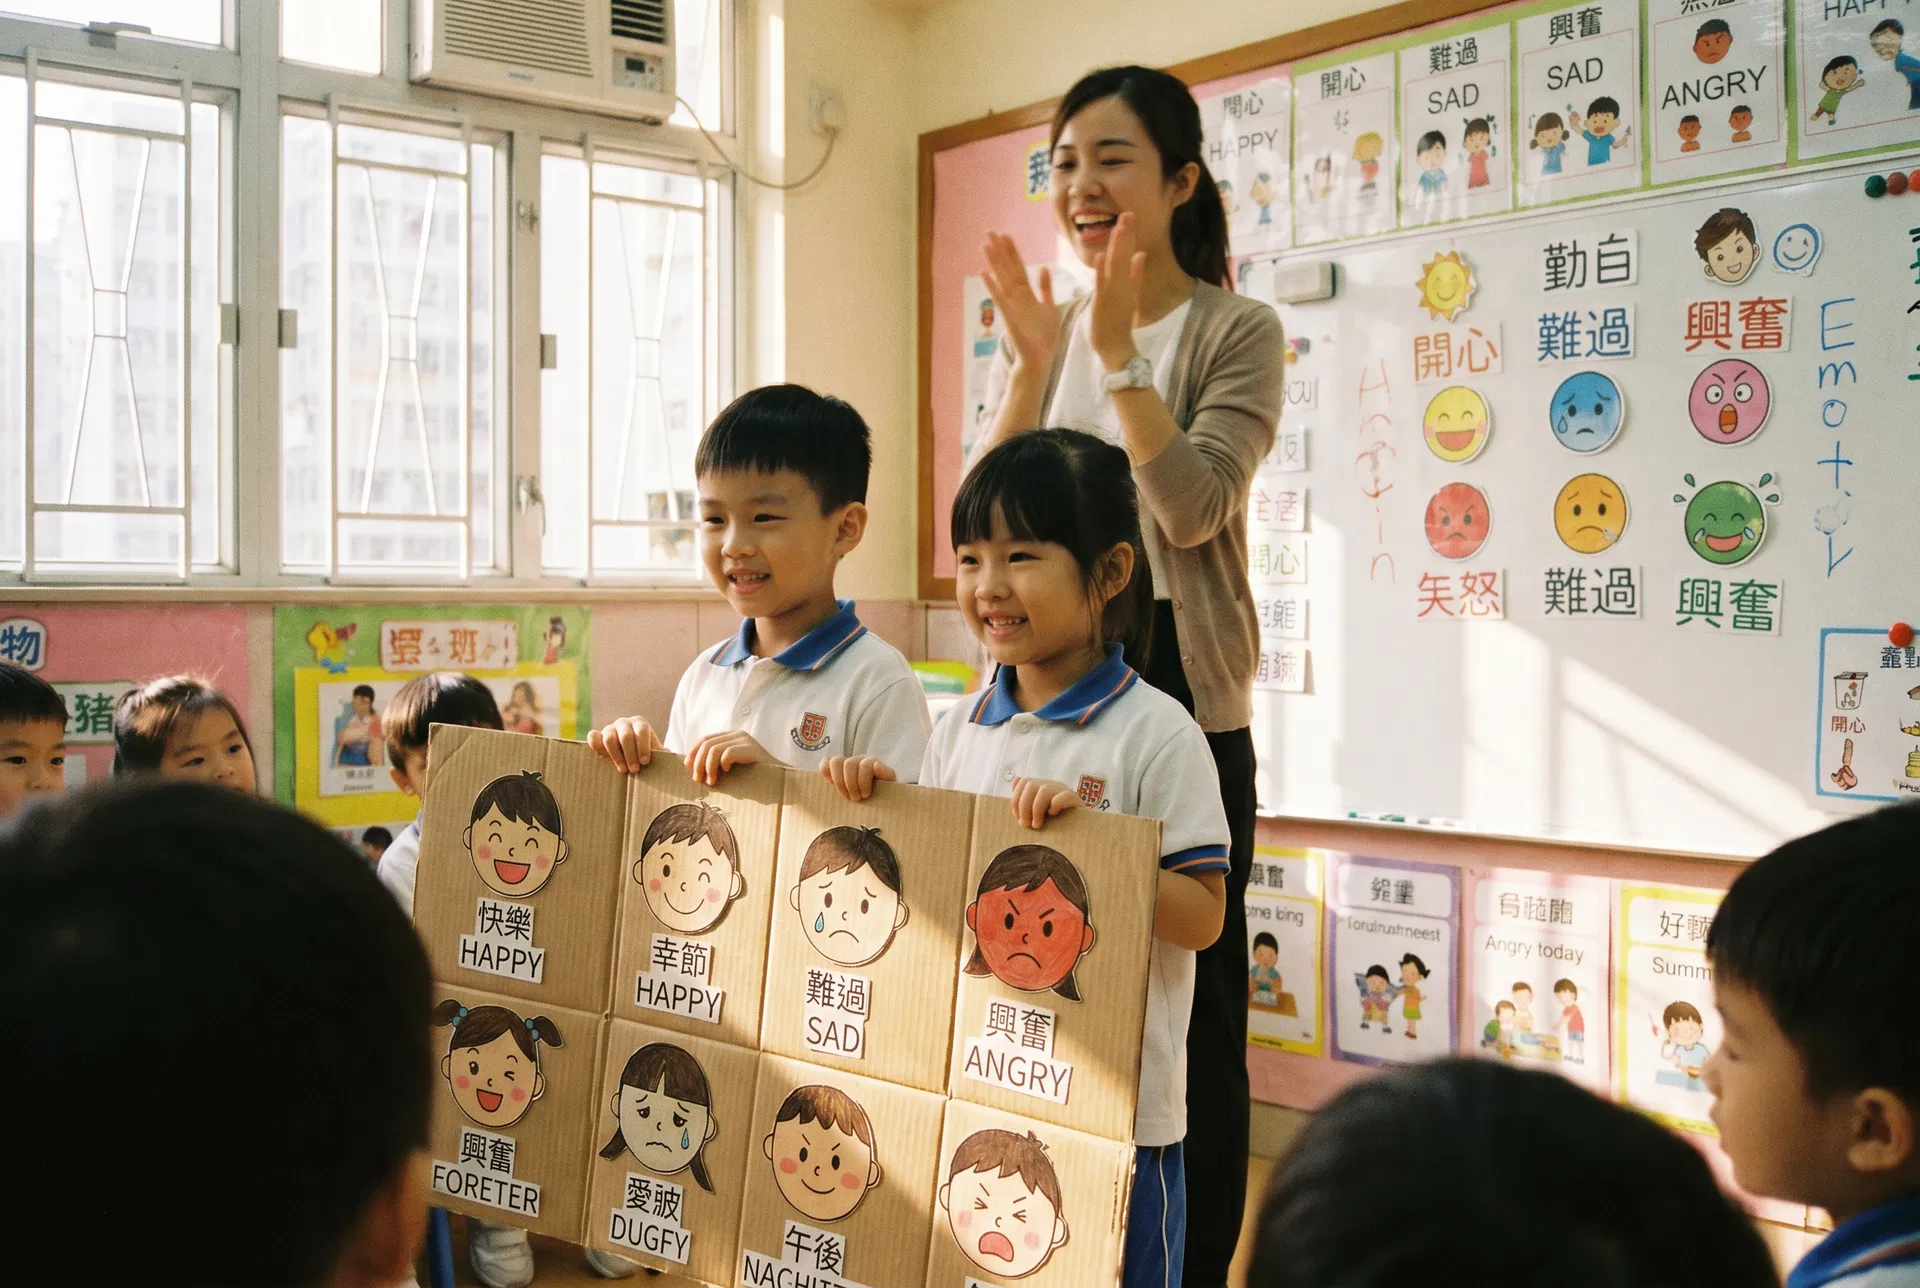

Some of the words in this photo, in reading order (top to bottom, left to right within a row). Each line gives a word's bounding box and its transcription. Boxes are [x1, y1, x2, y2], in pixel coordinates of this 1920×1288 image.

[1548, 7, 1602, 45] 興奮
[1429, 37, 1478, 74] 難過
[1547, 57, 1603, 90] SAD
[1320, 67, 1366, 99] 開心
[1427, 83, 1479, 114] SAD
[1661, 65, 1767, 109] ANGRY
[1210, 128, 1278, 162] HAPPY
[1538, 308, 1631, 361] 難過
[1684, 296, 1788, 352] 興奮
[1414, 328, 1498, 381] 開心
[1544, 567, 1637, 615] 難過
[1676, 578, 1777, 631] 興奮
[1831, 716, 1866, 733] 開心
[478, 900, 531, 941] 快樂
[461, 938, 543, 978] HAPPY
[653, 937, 708, 977] 幸節
[1485, 935, 1531, 959] Angry
[1538, 942, 1584, 965] today
[637, 975, 720, 1018] HAPPY
[806, 969, 866, 1015] 難過
[806, 1016, 860, 1053] SAD
[986, 1002, 1051, 1051] 興奮
[965, 1045, 1069, 1097] ANGRY
[460, 1132, 514, 1175] 興奮
[433, 1165, 538, 1214] FORETER
[611, 1214, 689, 1259] DUGFY
[785, 1225, 842, 1275] 午後
